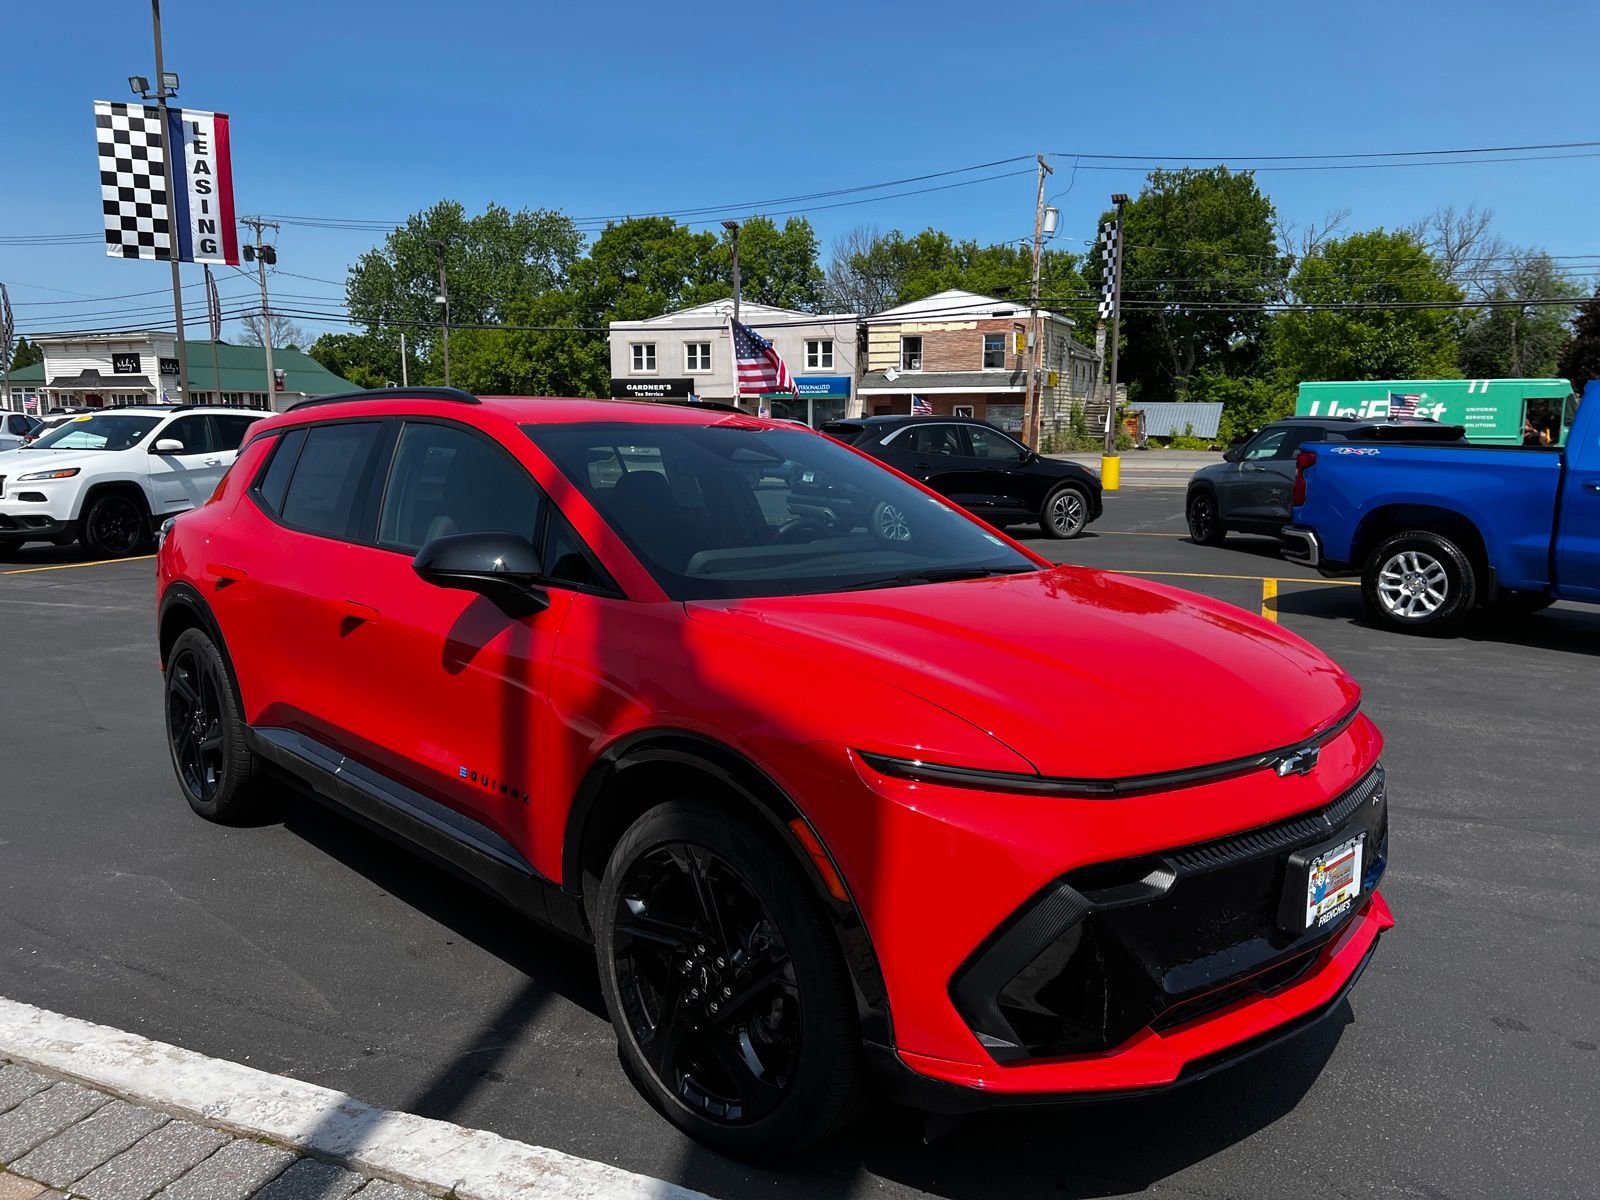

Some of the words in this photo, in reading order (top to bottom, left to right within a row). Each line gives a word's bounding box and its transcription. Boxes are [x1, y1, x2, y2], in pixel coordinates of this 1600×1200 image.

[192, 121, 218, 254] LEASING
[1309, 400, 1447, 421] UniFst
[1318, 899, 1351, 928] FRENCHIE'S
